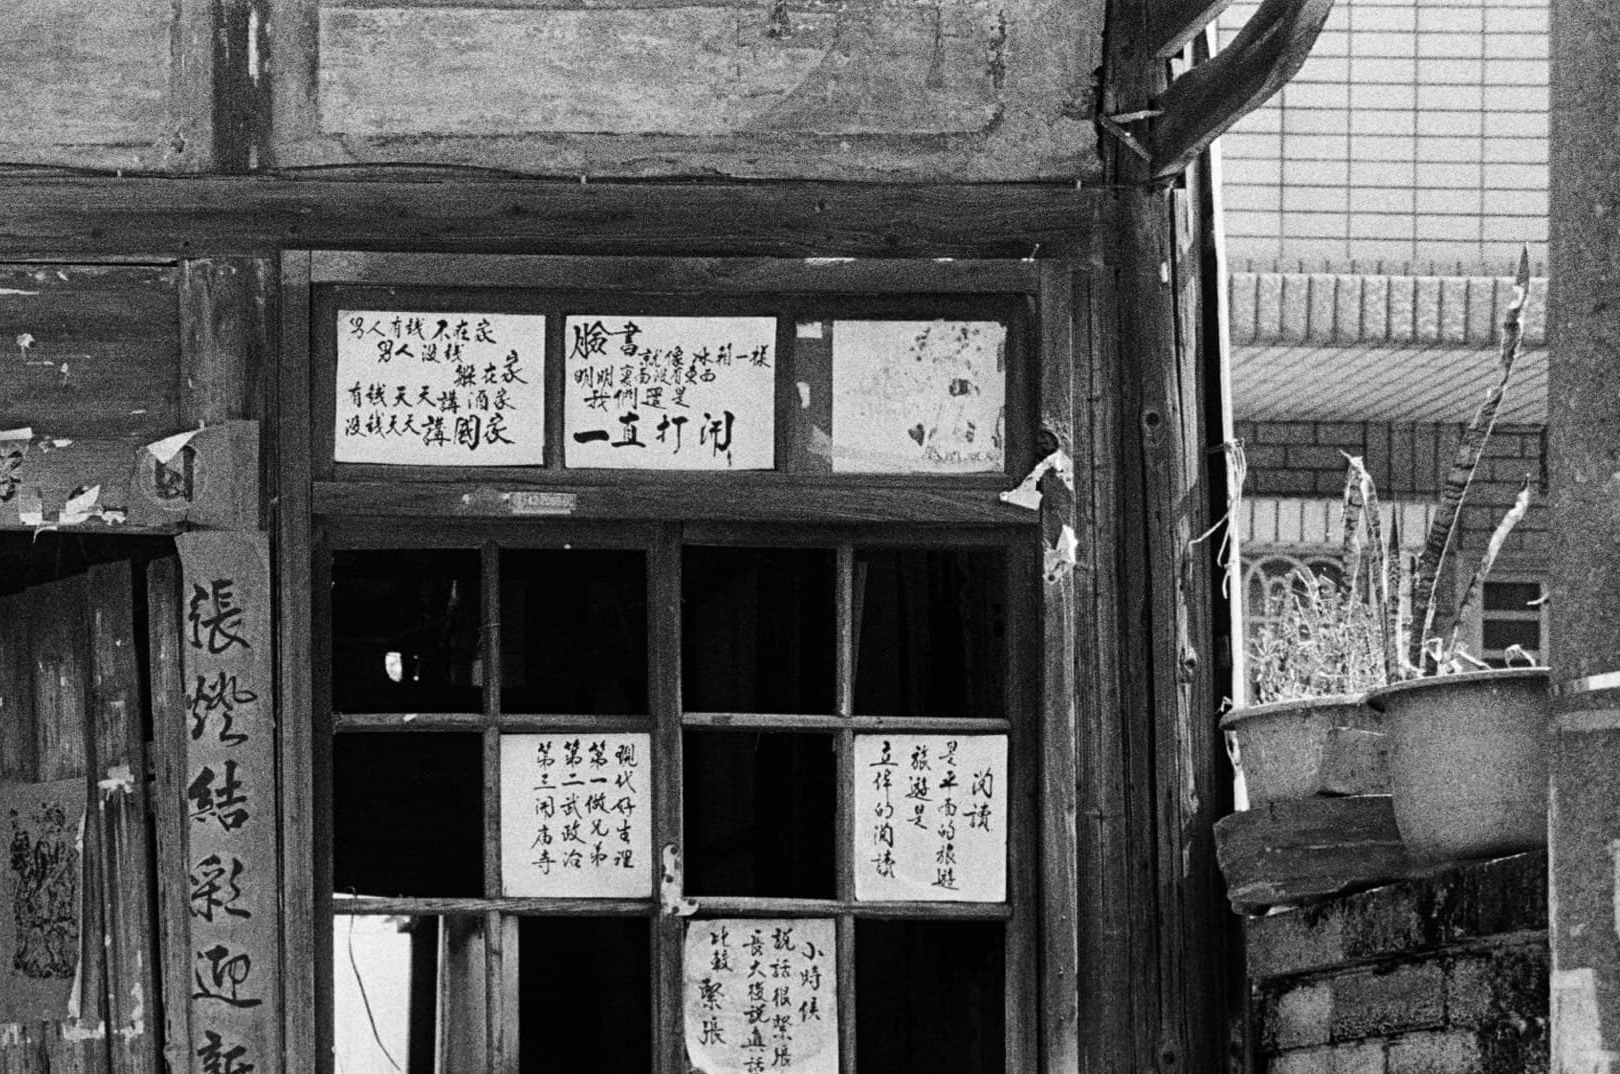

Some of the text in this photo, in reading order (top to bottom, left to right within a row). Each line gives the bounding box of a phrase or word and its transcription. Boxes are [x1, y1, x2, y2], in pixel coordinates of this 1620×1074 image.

[350, 316, 496, 344] 男人有錢不在家
[348, 382, 515, 414] 有錢天天講酒家
[585, 387, 690, 412] 我們還是
[573, 411, 735, 467] 一直打開
[585, 740, 611, 867] 第一做兄弟
[905, 744, 932, 830] 旅遊是
[931, 740, 959, 890] 是平面的旅遊
[963, 767, 993, 832] 閱讀
[698, 926, 732, 1045] 比較緊張
[799, 942, 824, 1022] 小時候
